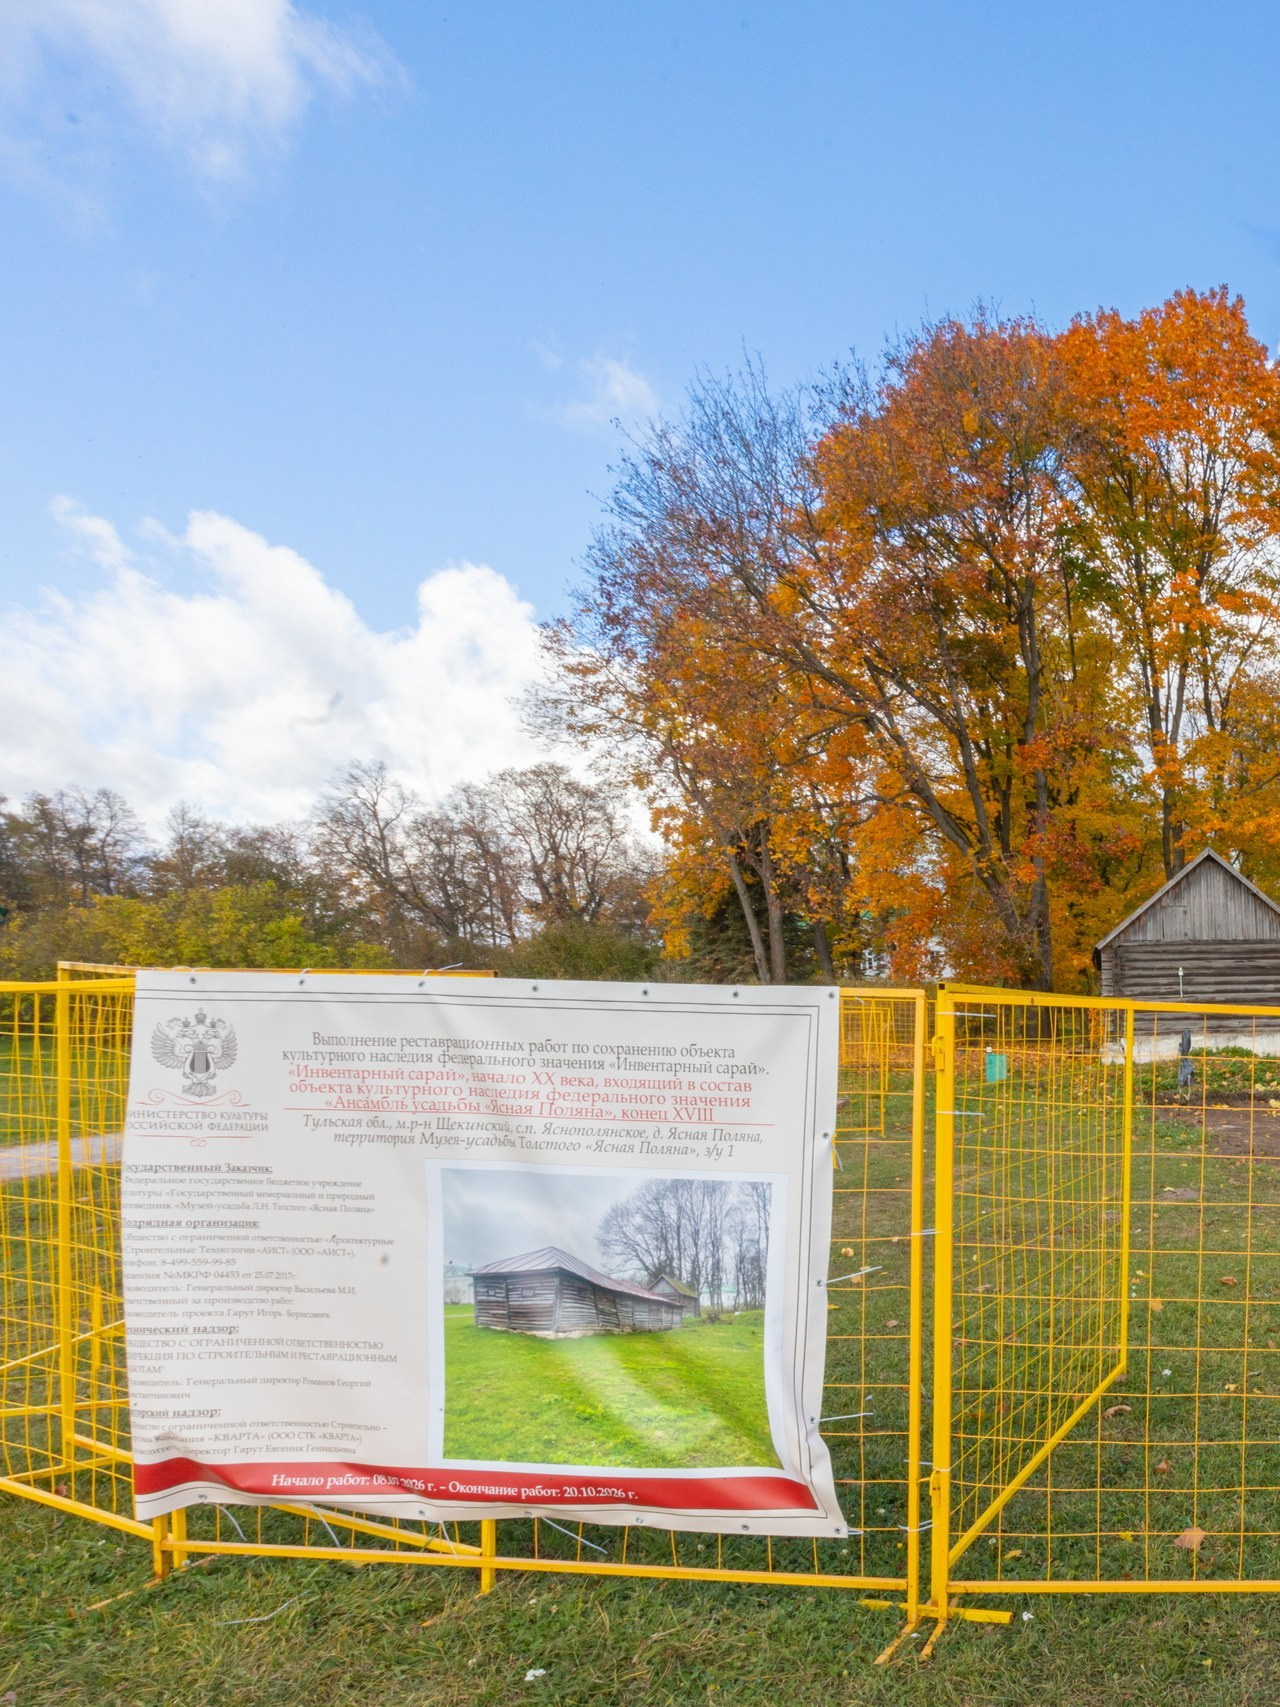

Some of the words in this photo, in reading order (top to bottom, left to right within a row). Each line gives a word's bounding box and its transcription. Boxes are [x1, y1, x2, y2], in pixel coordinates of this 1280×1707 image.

[312, 1032, 397, 1047] Выполнение
[400, 1037, 525, 1052] реставрационных
[528, 1039, 568, 1055] работ
[571, 1044, 589, 1054] по
[593, 1045, 677, 1060] сохранению
[680, 1044, 735, 1059] объекта
[282, 1050, 366, 1066] культурного
[369, 1050, 433, 1064] наследия
[437, 1050, 536, 1068] федерального
[539, 1058, 605, 1070] значения
[609, 1058, 712, 1076] «Инвентарный
[716, 1061, 770, 1078] сарай».
[288, 1064, 408, 1082] «Инвентарный
[408, 1067, 470, 1083] сарай»,
[472, 1072, 526, 1085] начало
[531, 1071, 556, 1086] XX
[560, 1075, 599, 1088] века,
[604, 1077, 686, 1092] входящий
[687, 1081, 696, 1090] в
[699, 1081, 753, 1092] состав
[289, 1080, 353, 1095] объекта
[357, 1083, 463, 1099] культурного
[468, 1086, 541, 1100] наследия
[546, 1087, 666, 1106] федерального
[671, 1095, 751, 1108] значения
[325, 1095, 409, 1111] «Ансамбль
[412, 1098, 481, 1115] усадьбы
[484, 1101, 533, 1115] «Ясная
[539, 1102, 617, 1120] Поляна»,
[621, 1107, 668, 1122] конец
[672, 1106, 714, 1122] XVIII
[220, 1111, 268, 1121] КУЛЬТУРЫ
[127, 1120, 203, 1131] ОССИЙСКОЙ
[207, 1121, 269, 1132] ФЕДЕРАЦИИ
[303, 1114, 363, 1131] Тульская
[366, 1115, 393, 1130] обл.,
[395, 1119, 432, 1133] м.р-н
[436, 1117, 514, 1134] Щекинский,
[516, 1123, 537, 1135] с.п.
[541, 1122, 649, 1140] Яснополянское,
[652, 1125, 664, 1140] д.
[667, 1126, 708, 1142] Ясная
[711, 1128, 763, 1144] Поляна,
[334, 1131, 416, 1146] территория
[419, 1132, 516, 1149] Музея-усадьбы
[518, 1136, 581, 1151] Толстого
[585, 1138, 635, 1154] «Ясная
[638, 1141, 700, 1157] Поляна»,
[703, 1143, 723, 1161] з/у
[727, 1144, 734, 1157] 1
[225, 1162, 273, 1174] Заказчик:
[189, 1177, 264, 1187] государственное
[311, 1179, 363, 1190] учреждение
[326, 1192, 376, 1202] природный
[186, 1219, 260, 1230] организация:
[178, 1233, 250, 1244] ограниченной
[199, 1245, 255, 1254] Технологии
[213, 1271, 240, 1279] 04453
[186, 1284, 253, 1293] Генеральный
[182, 1310, 224, 1319] проекта
[193, 1325, 239, 1336] надзор:
[189, 1338, 285, 1348] ОГРАНИЧЕННОЙ
[176, 1352, 196, 1361] ПО
[197, 1350, 290, 1361] СТРОИТЕЛЬНЫМ
[186, 1377, 257, 1387] Генеральный
[172, 1408, 222, 1419] надзор:
[168, 1420, 247, 1432] ограниченной
[271, 1473, 324, 1487] Начало
[326, 1474, 370, 1489] работ:
[373, 1474, 425, 1491] 08.072026
[427, 1482, 437, 1491] г.
[448, 1481, 518, 1496] Окончание
[521, 1482, 561, 1498] работ:
[563, 1484, 626, 1499] 20.10.2026
[628, 1490, 639, 1500] г.
